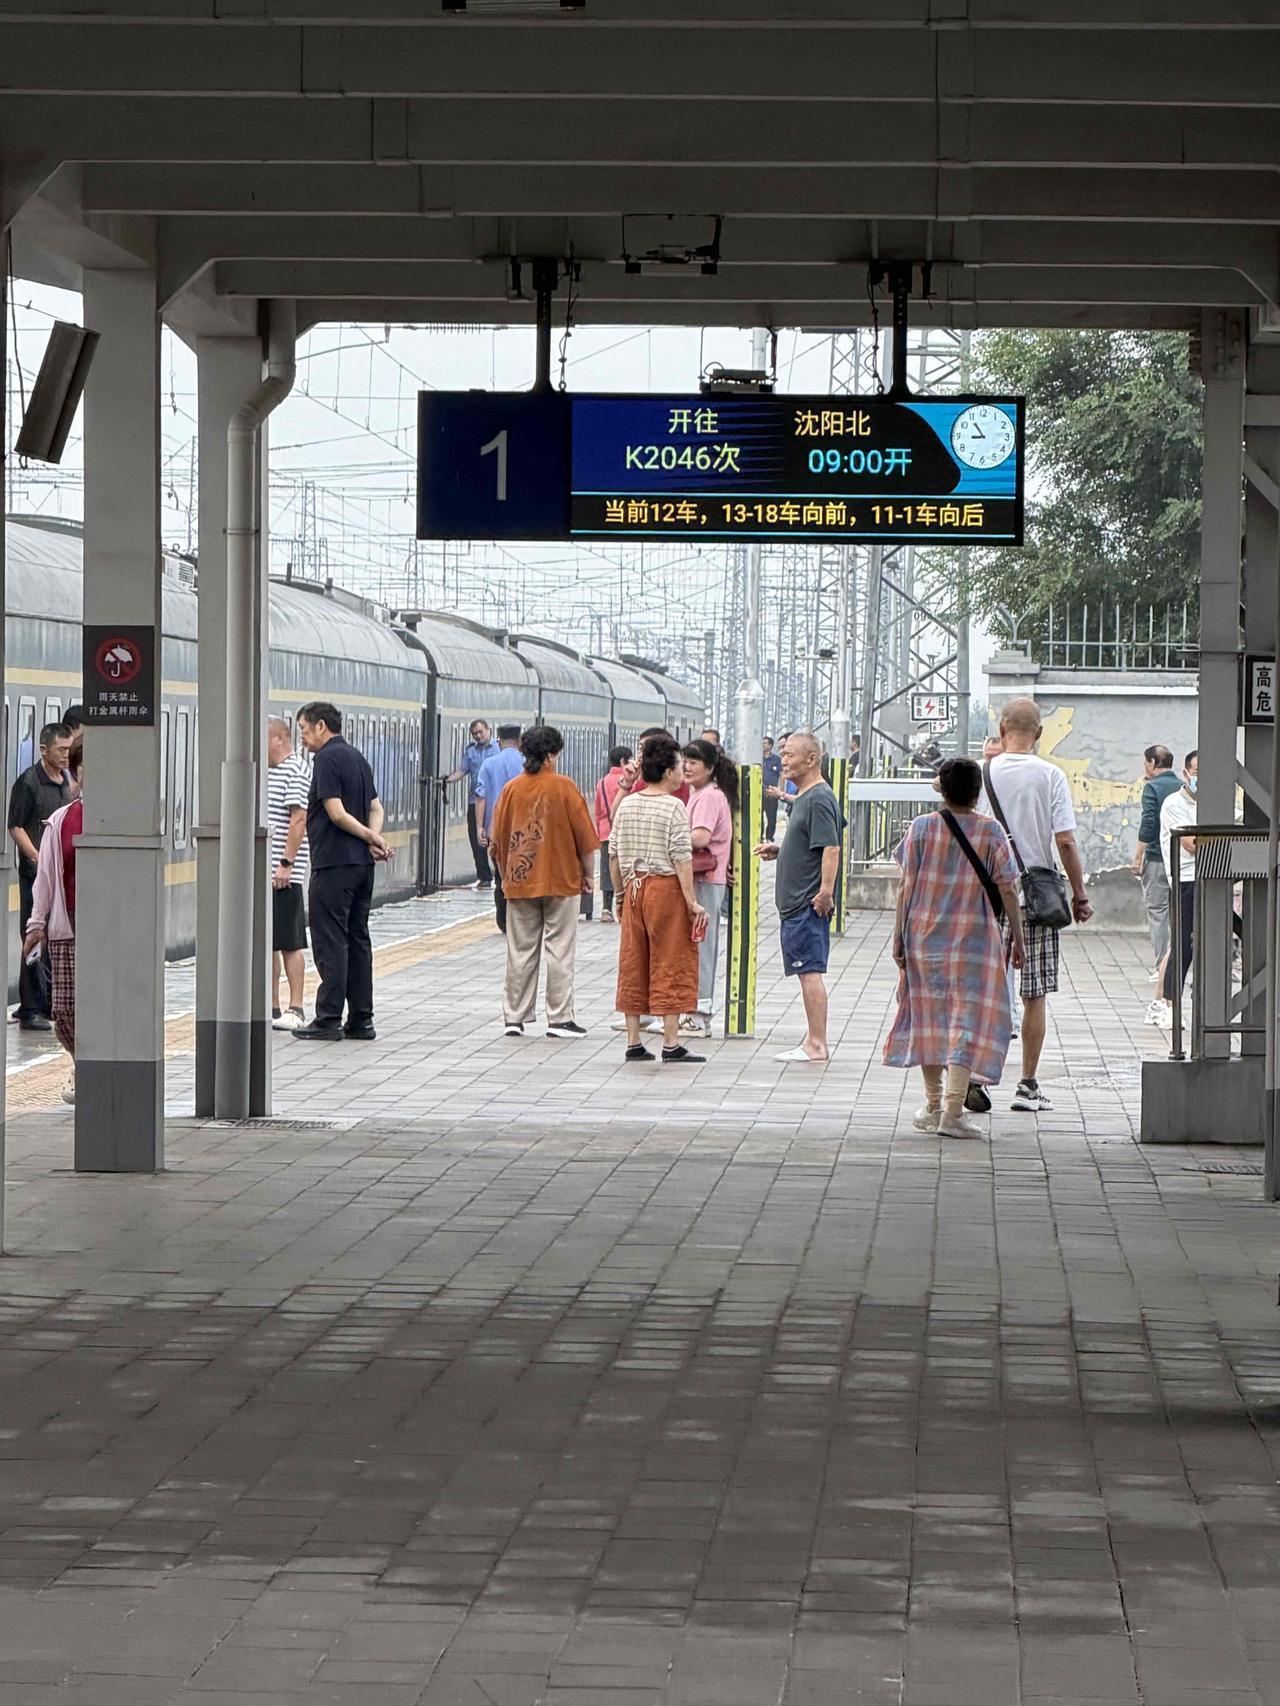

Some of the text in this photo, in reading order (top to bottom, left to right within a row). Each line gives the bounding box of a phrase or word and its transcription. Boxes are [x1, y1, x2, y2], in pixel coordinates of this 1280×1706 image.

[968, 412, 975, 421] 11
[979, 408, 988, 418] 12
[993, 412, 997, 421] 1
[668, 408, 719, 434] 开往
[794, 410, 871, 436] 沈阳北
[960, 421, 969, 430] 10
[1000, 420, 1007, 430] 2
[955, 432, 962, 440] 9
[1004, 432, 1011, 441] 3
[959, 443, 966, 453] 8
[999, 444, 1006, 453] 4
[625, 442, 741, 473] K2046次
[969, 452, 976, 461] 7
[480, 430, 507, 501] 1
[808, 448, 913, 477] 09:00开
[1256, 665, 1272, 712] 高危
[99, 691, 139, 702] 雨天禁止
